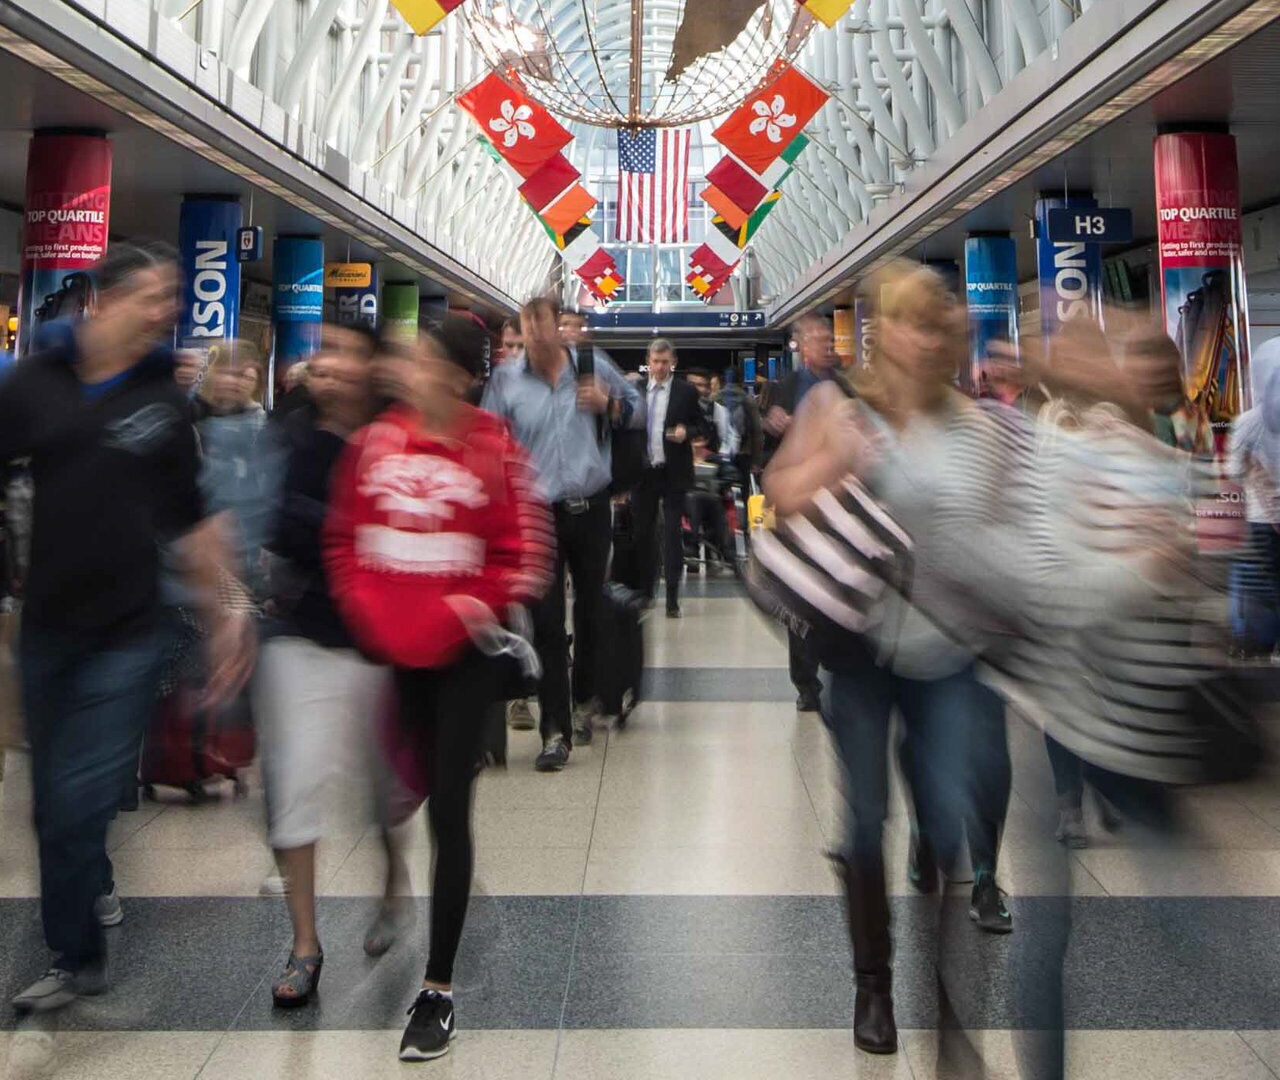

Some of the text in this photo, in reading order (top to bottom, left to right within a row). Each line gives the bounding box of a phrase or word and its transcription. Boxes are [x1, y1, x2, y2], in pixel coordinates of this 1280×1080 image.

[27, 210, 104, 224] TOP QUARTILE
[1160, 207, 1237, 222] TOP QUARTILE
[1075, 215, 1105, 235] H3
[53, 243, 69, 251] first
[1189, 241, 1205, 249] first
